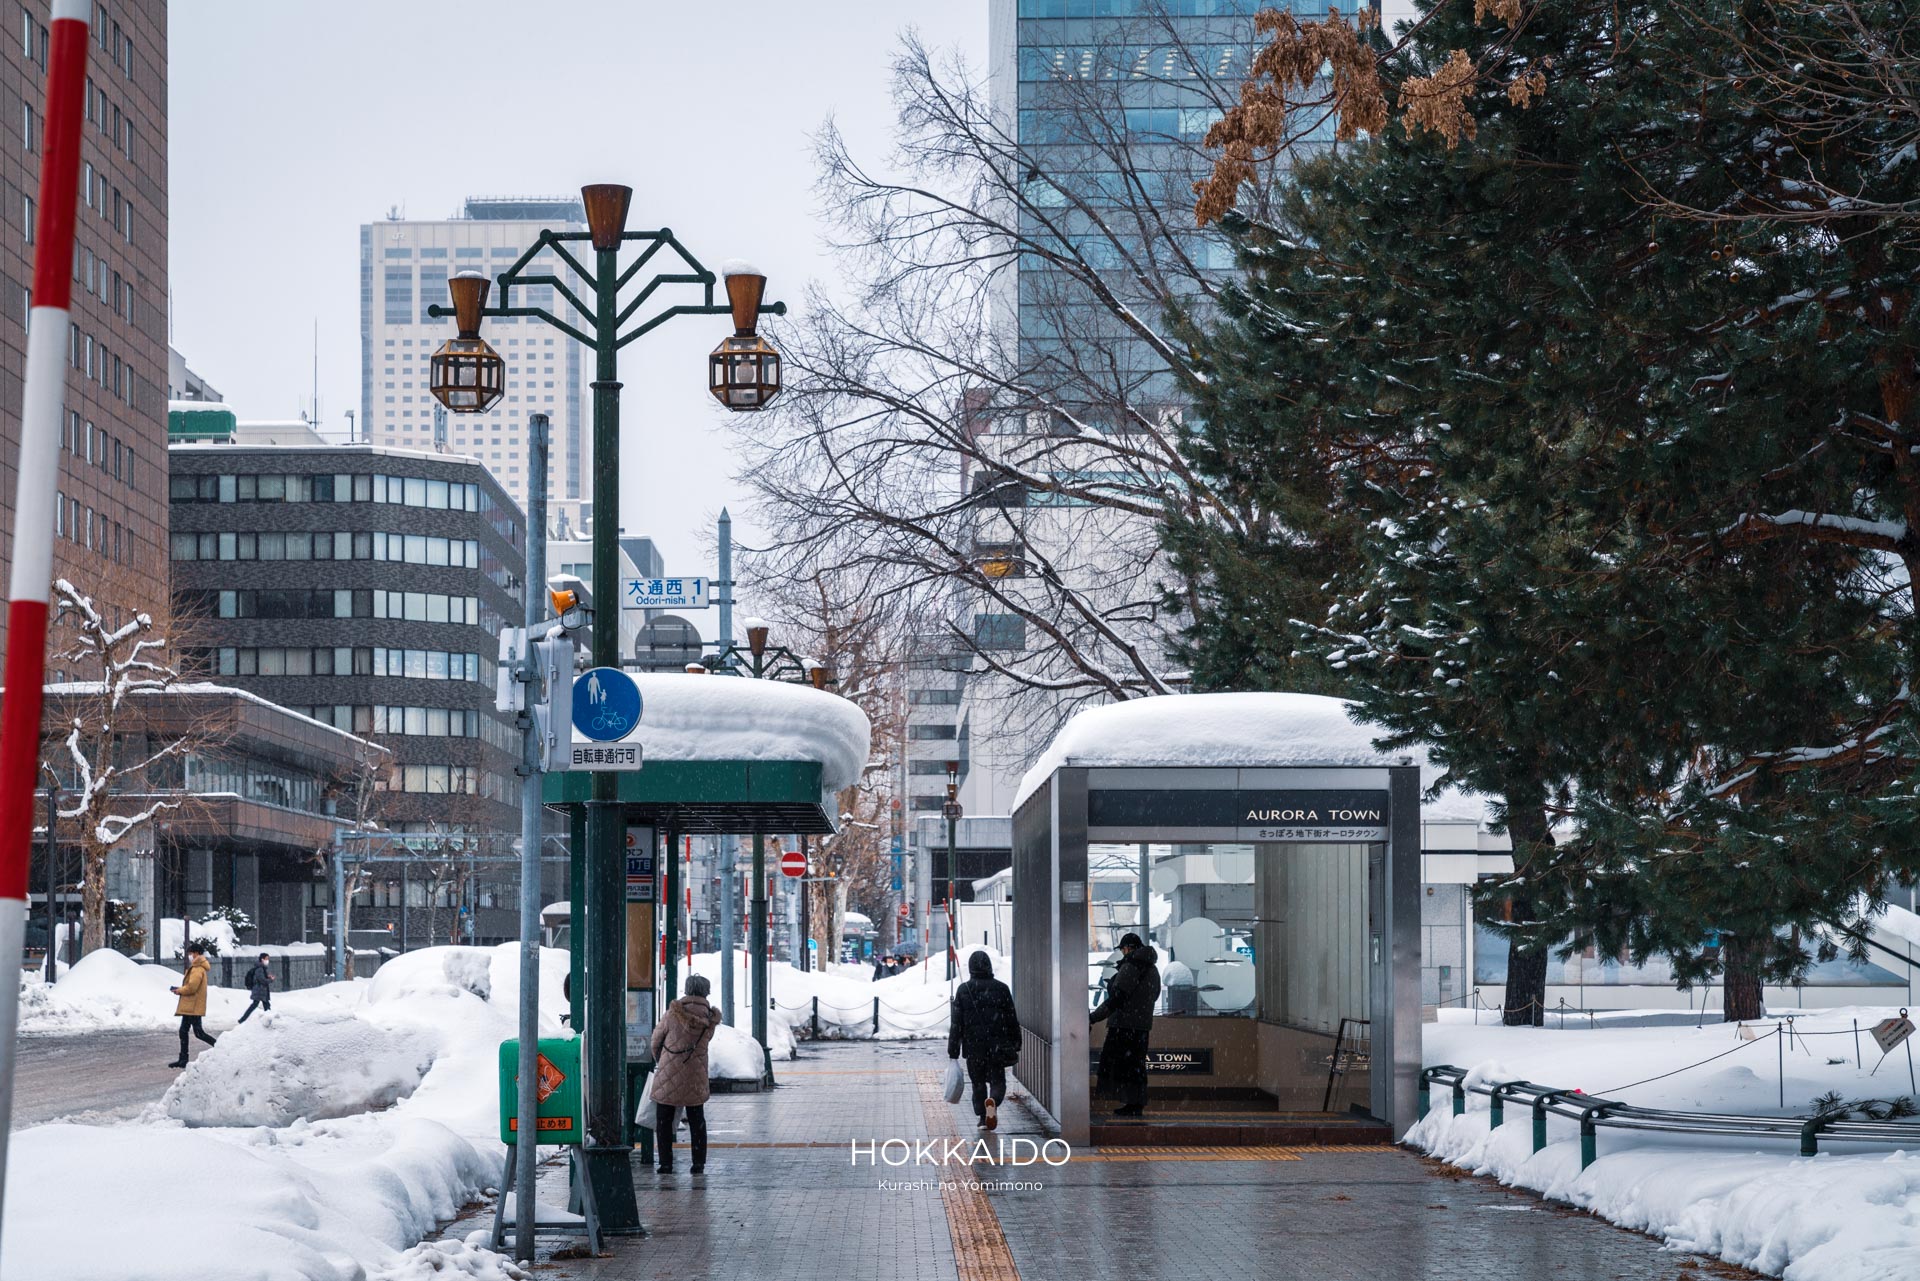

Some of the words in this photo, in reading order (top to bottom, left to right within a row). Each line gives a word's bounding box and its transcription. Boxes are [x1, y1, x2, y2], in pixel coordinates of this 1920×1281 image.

[628, 579, 683, 595] 大通西
[692, 580, 701, 595] 1
[636, 595, 686, 605] Odori-nishi
[691, 596, 696, 605] 1
[573, 748, 636, 764] 自転車通行可
[1246, 809, 1318, 821] AURORA
[1328, 809, 1380, 821] TOWN
[1259, 829, 1379, 838] さっぽろ地下街オーロラタウン
[1156, 1053, 1192, 1062] TOWN
